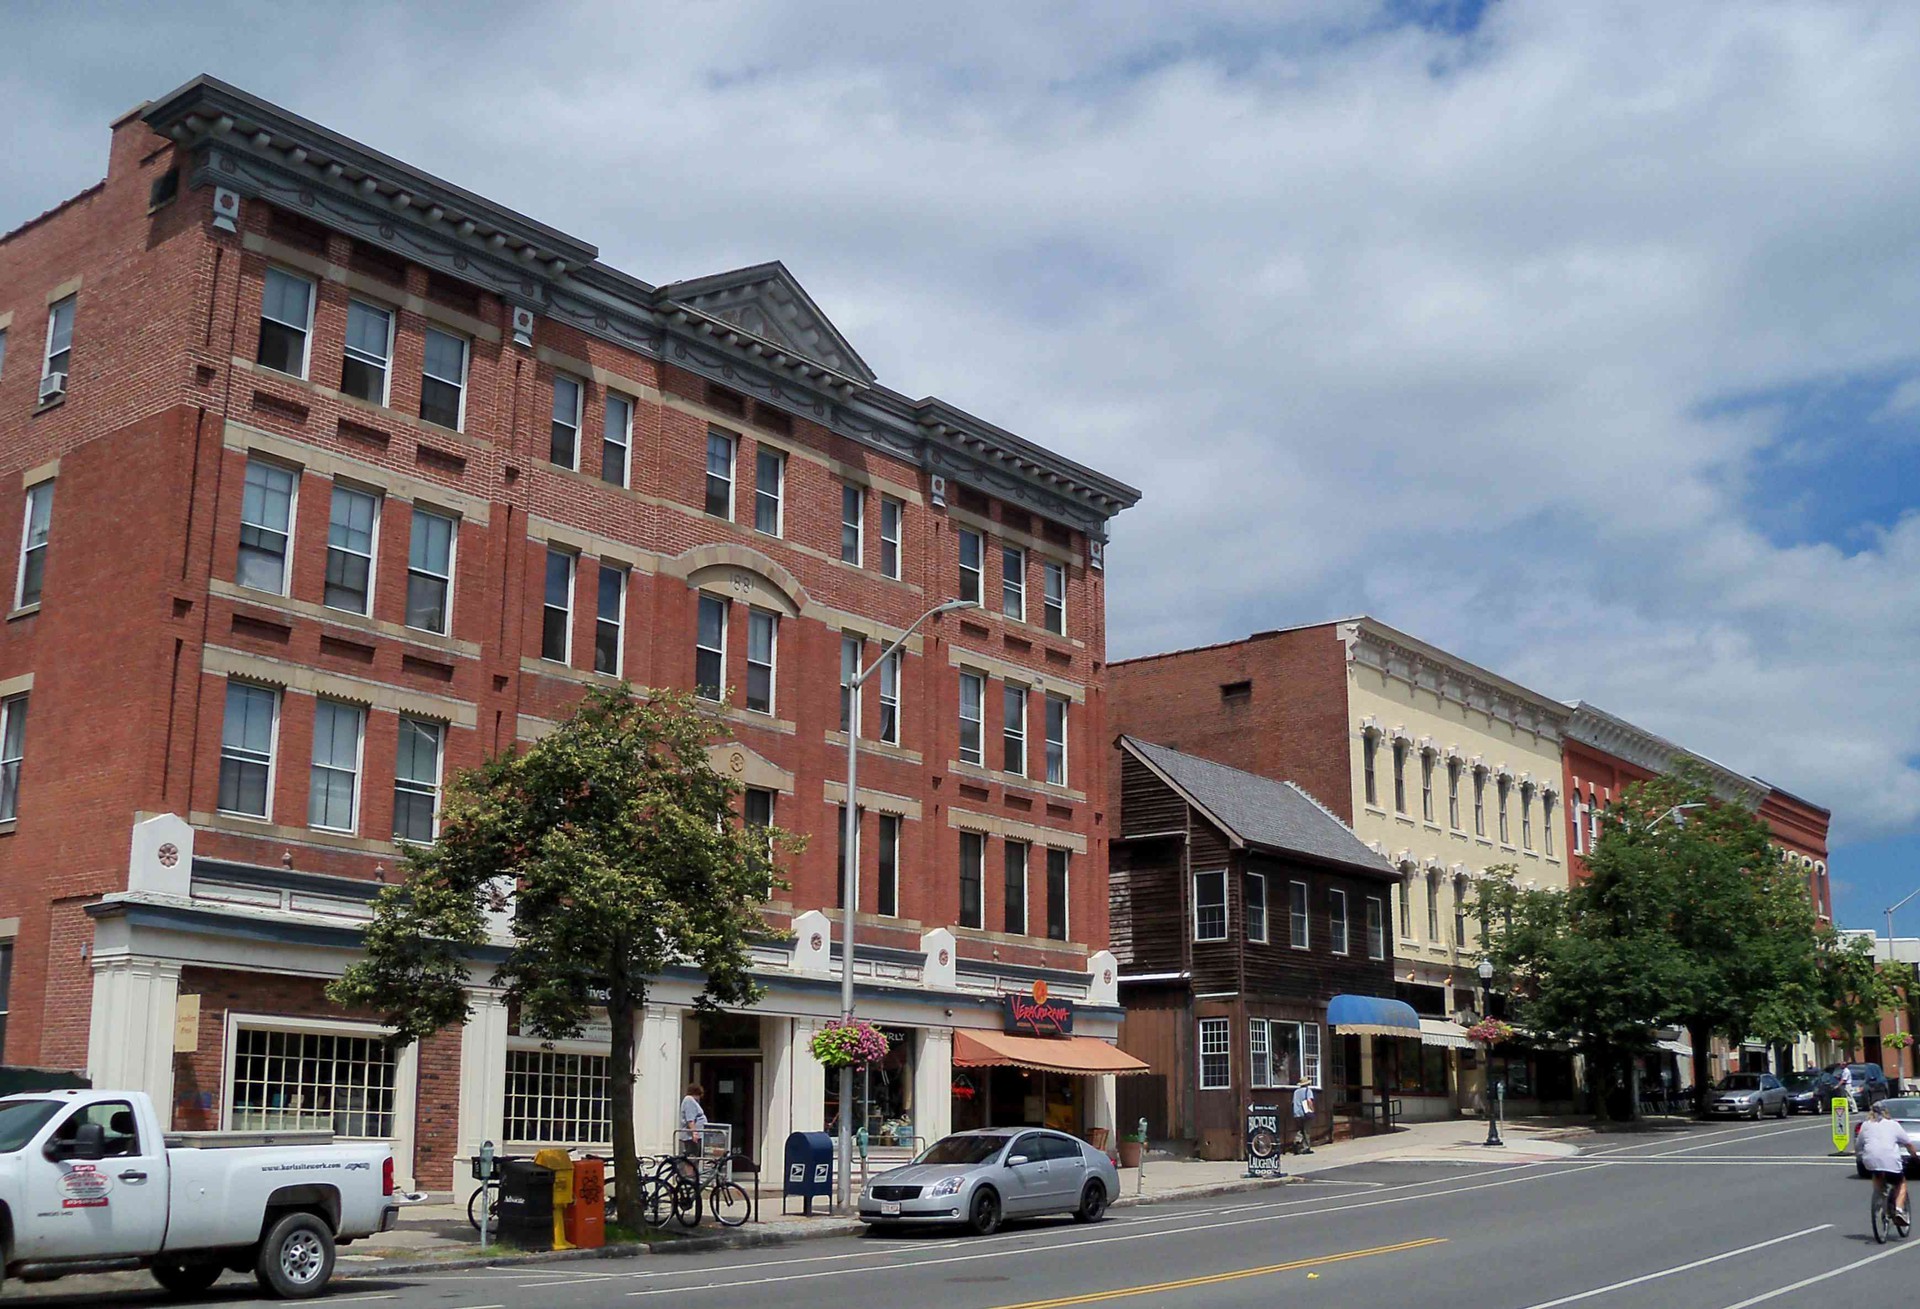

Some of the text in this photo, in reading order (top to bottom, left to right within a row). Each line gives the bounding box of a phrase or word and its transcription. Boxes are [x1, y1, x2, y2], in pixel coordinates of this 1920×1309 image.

[730, 574, 754, 593] 1881
[1248, 1116, 1276, 1133] BICYCLES
[1248, 1154, 1278, 1169] LAUGHING
